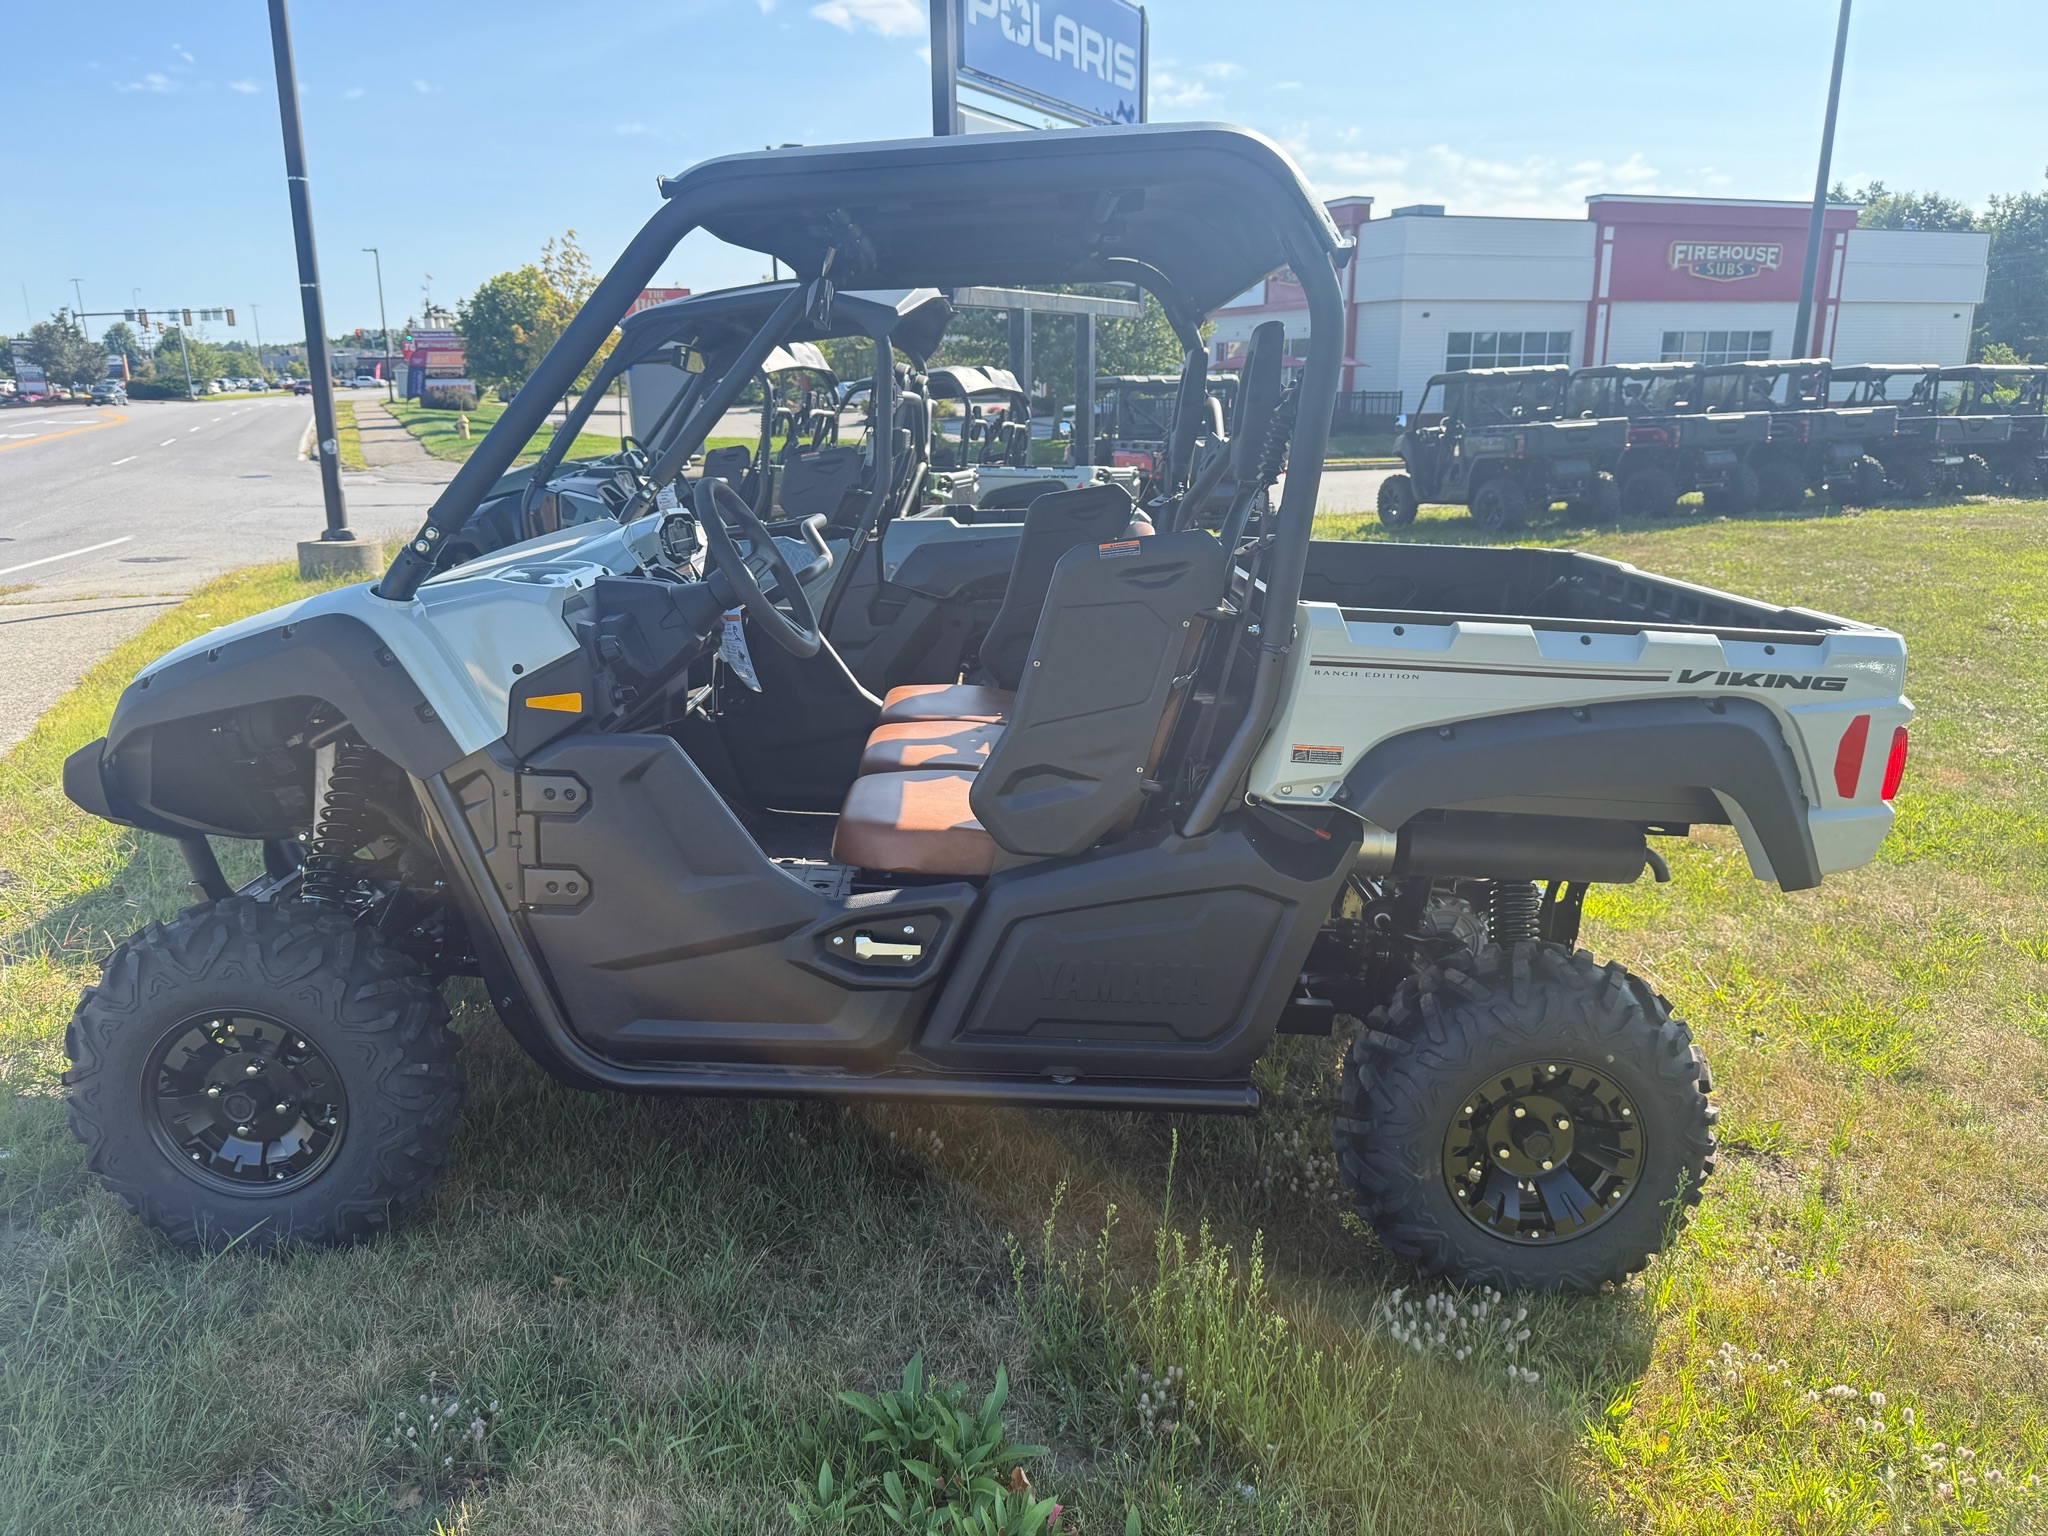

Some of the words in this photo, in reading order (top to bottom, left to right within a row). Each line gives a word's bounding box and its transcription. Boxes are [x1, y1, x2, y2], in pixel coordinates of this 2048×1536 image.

[967, 0, 1137, 91] POLARIS
[1673, 244, 1779, 270] FIREHOUSE
[1706, 262, 1744, 276] SUBS
[1365, 672, 1420, 680] EDITION
[1677, 669, 1848, 692] VIKING
[1034, 958, 1208, 1006] YAMAHA
